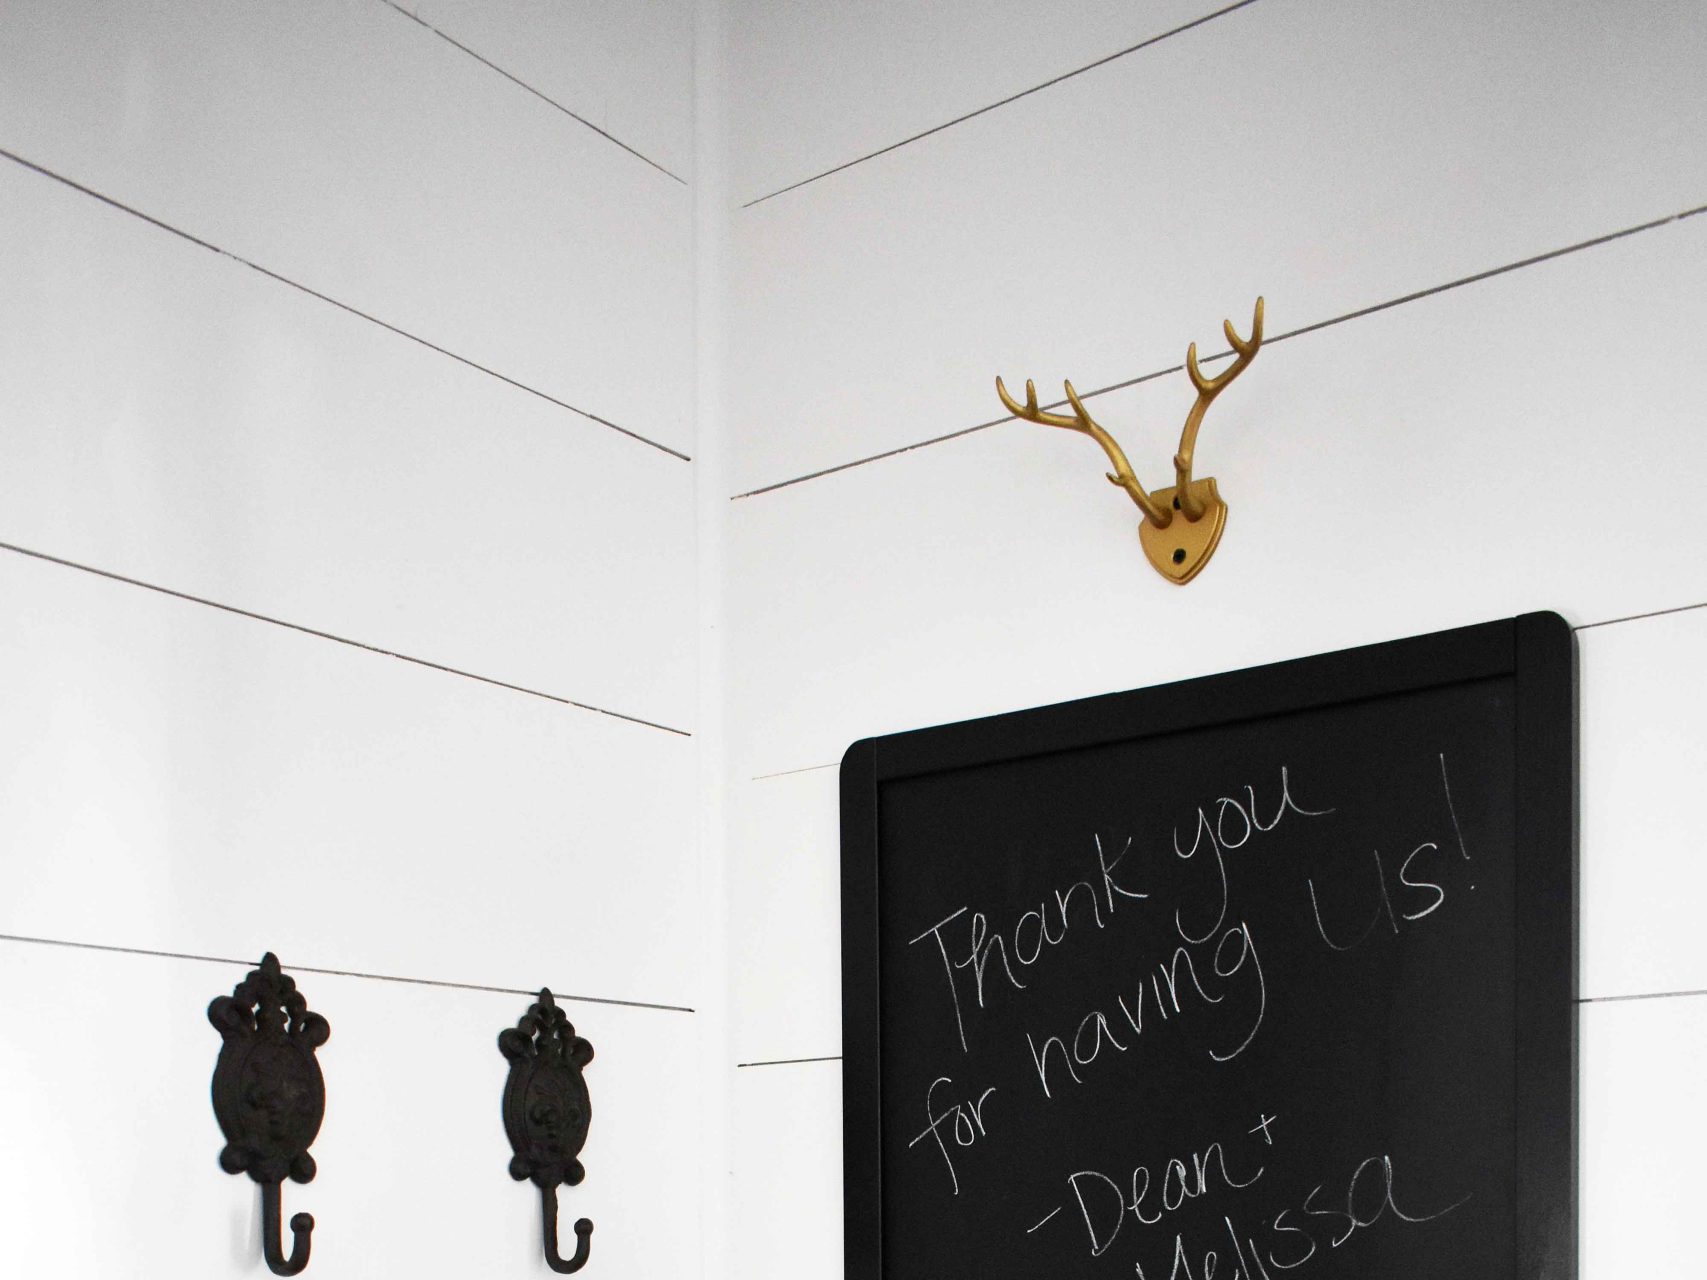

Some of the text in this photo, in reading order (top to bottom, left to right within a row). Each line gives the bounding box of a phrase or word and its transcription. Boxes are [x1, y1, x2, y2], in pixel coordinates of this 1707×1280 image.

[909, 766, 1336, 1053] Thank you
[909, 1077, 996, 1195] for
[1027, 922, 1266, 1099] having
